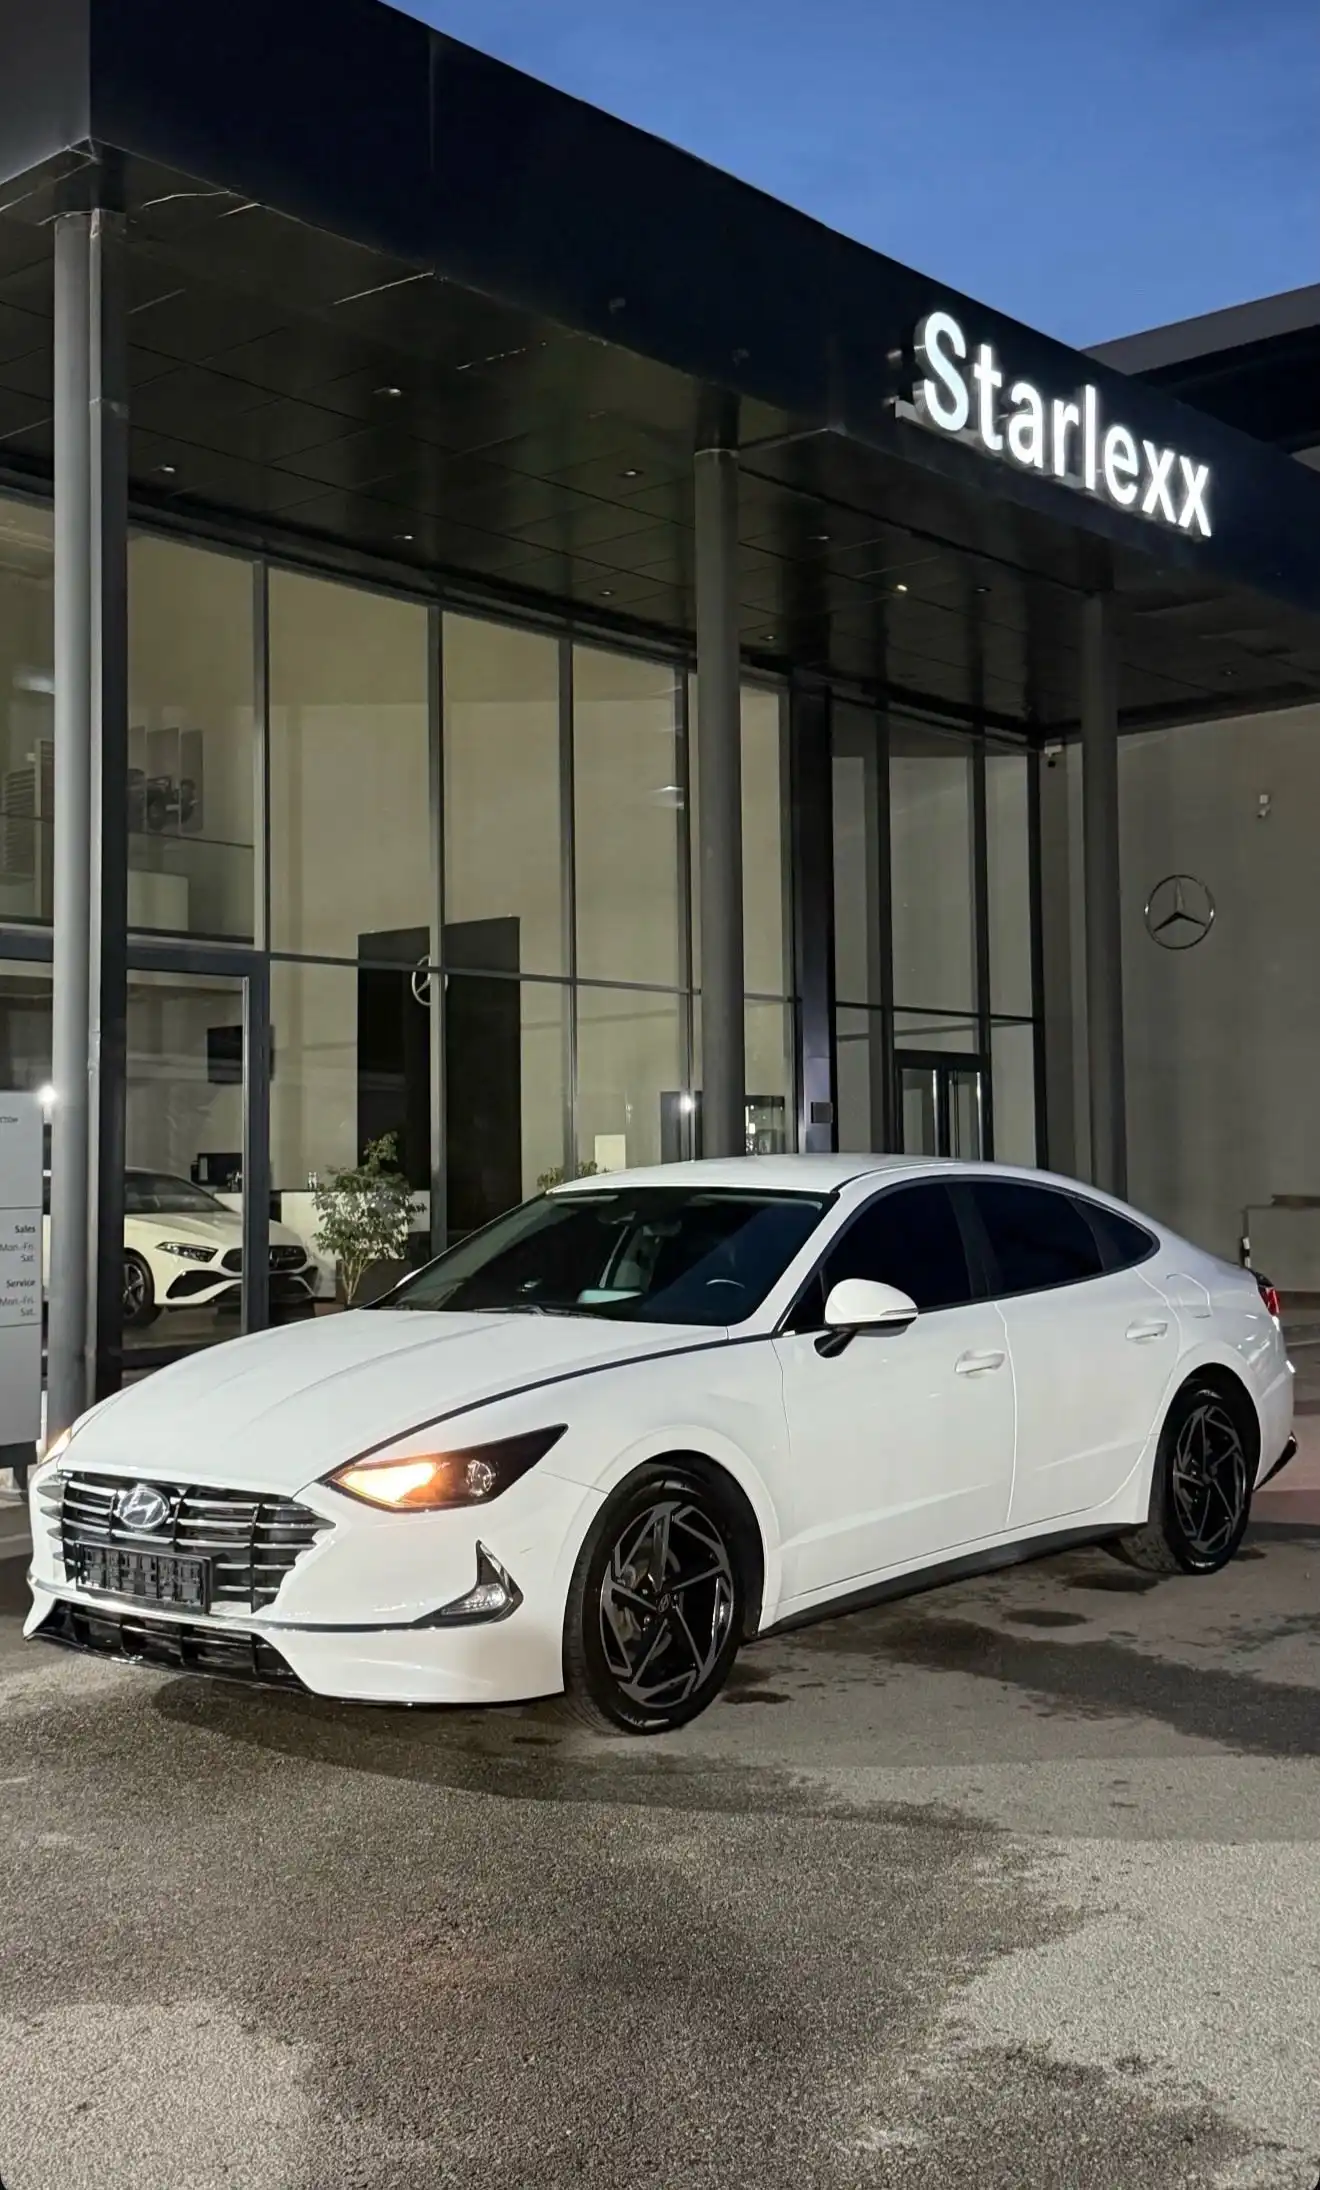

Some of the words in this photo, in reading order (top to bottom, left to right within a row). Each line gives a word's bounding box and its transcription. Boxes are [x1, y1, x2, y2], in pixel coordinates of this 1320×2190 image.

[920, 311, 1212, 537] Starlexx
[14, 1224, 36, 1233] Sales
[6, 1279, 36, 1288] Service
